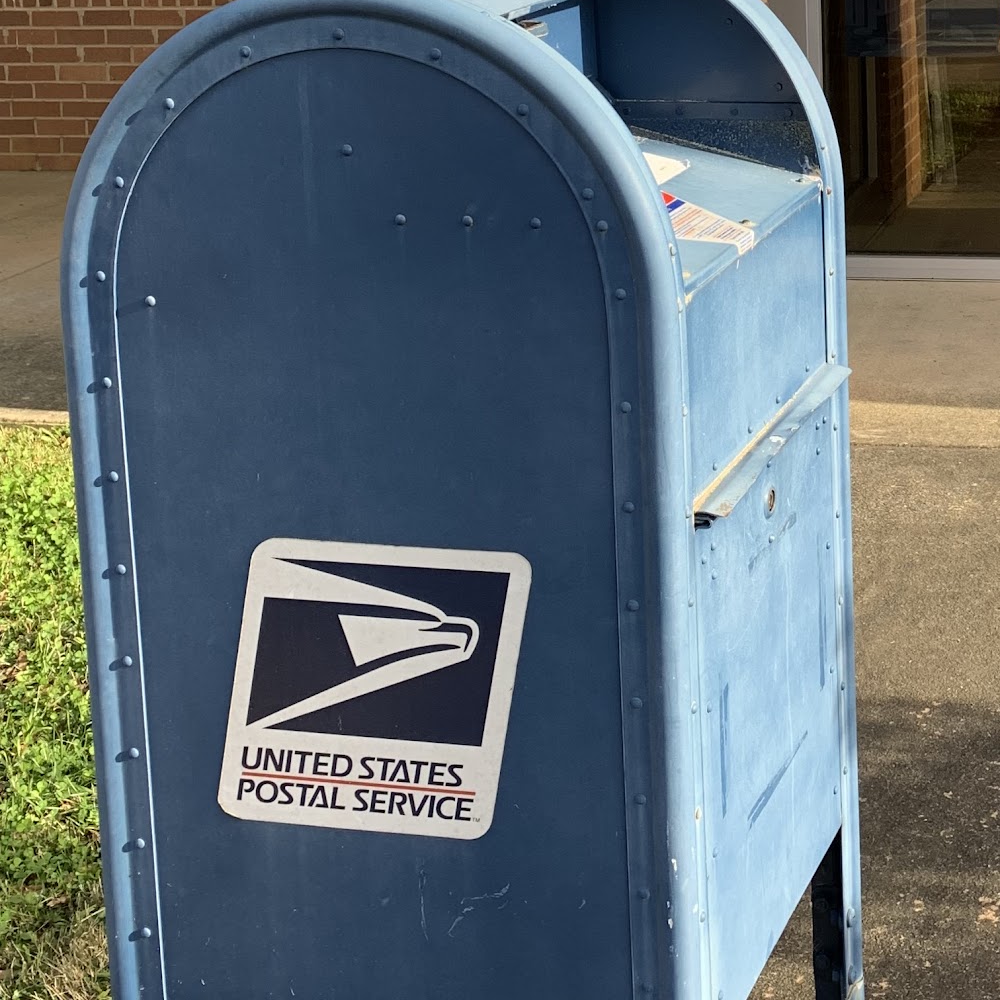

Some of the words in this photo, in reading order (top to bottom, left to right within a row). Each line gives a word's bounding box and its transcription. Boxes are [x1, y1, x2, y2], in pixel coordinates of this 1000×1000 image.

[241, 746, 353, 777] UNITED
[358, 756, 464, 787] STATES
[236, 778, 346, 810] POSTAL
[352, 789, 474, 822] SERVICE
